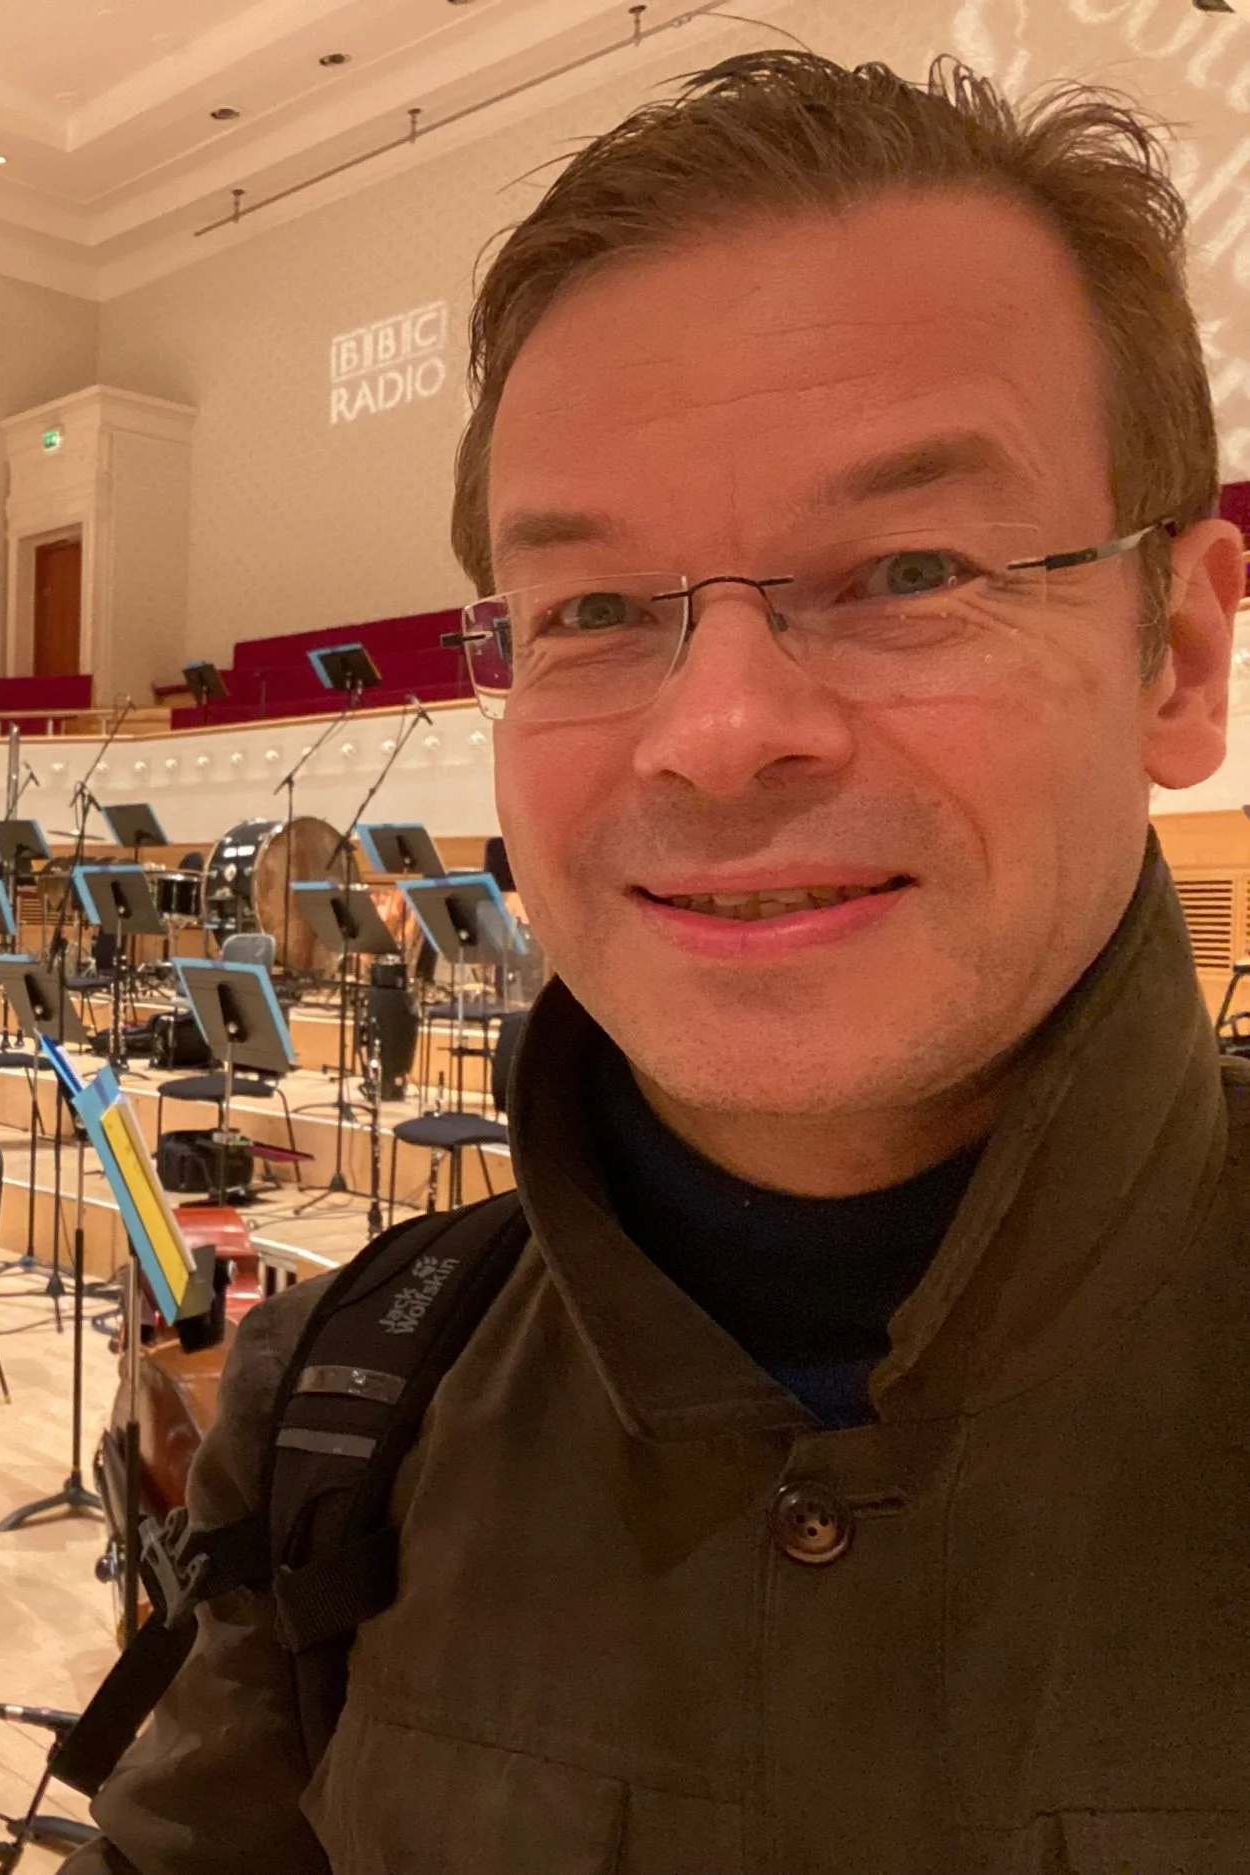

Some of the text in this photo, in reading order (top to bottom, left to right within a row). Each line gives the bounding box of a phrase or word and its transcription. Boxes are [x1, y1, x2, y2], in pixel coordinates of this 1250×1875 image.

[336, 305, 442, 377] BBC
[330, 356, 445, 425] RADIO
[379, 1287, 416, 1333] Jack
[393, 1259, 460, 1334] Wolfskin
